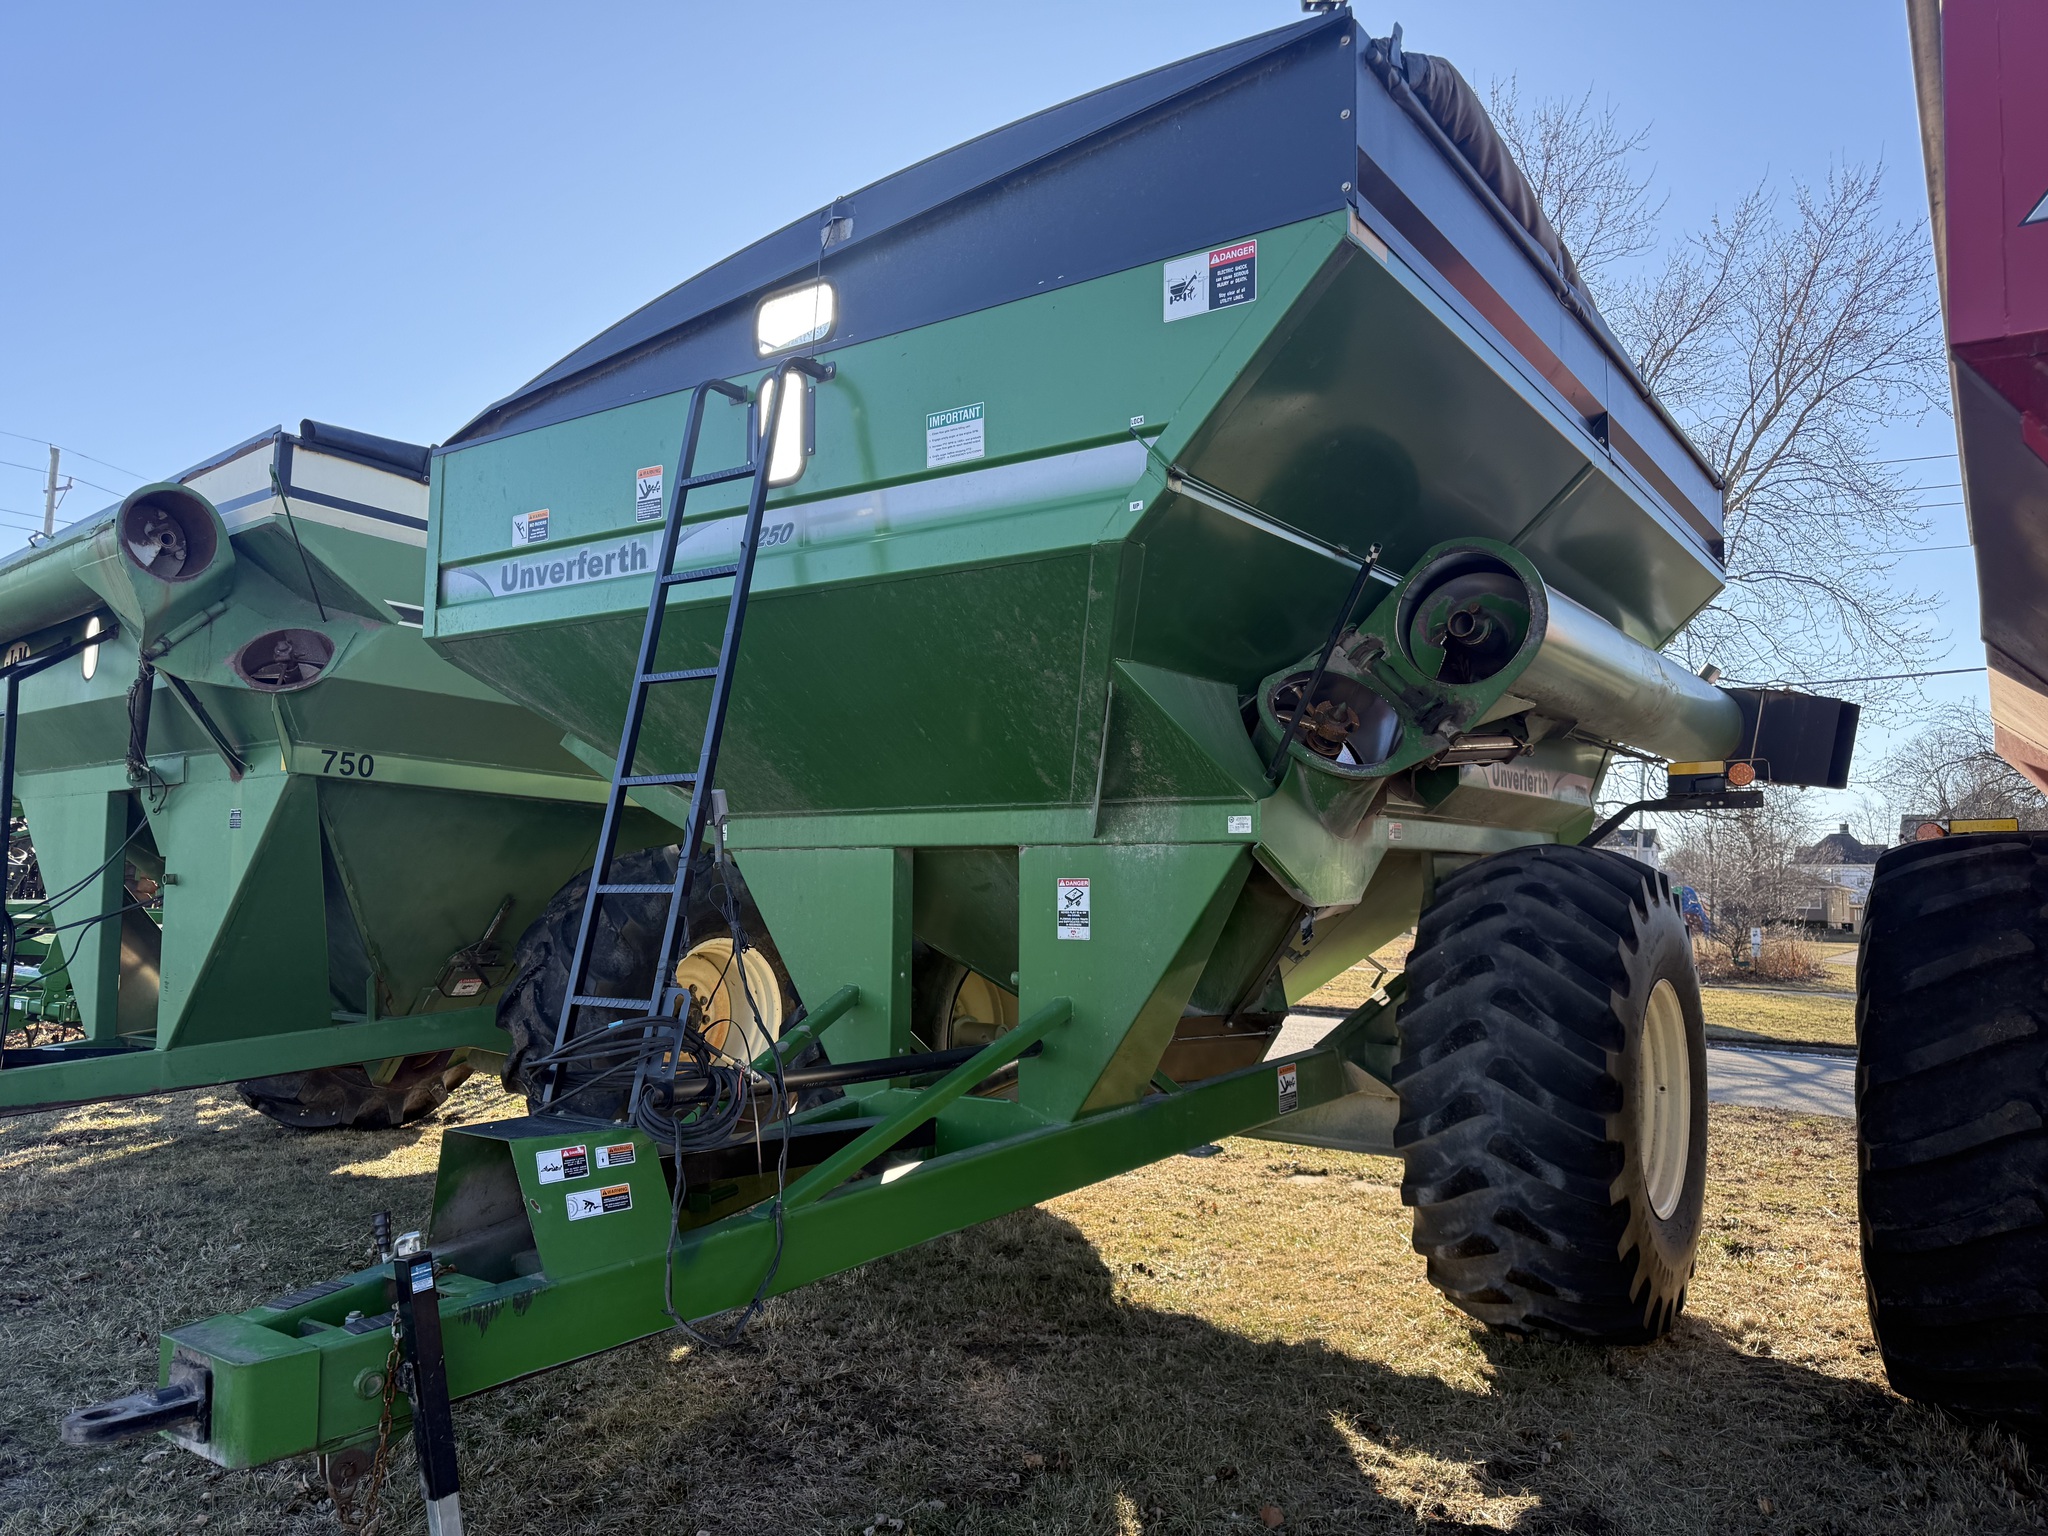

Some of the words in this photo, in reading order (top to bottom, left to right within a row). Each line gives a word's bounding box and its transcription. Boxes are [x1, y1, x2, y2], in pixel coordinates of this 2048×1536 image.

[1220, 245, 1255, 262] DANGER
[929, 406, 981, 428] IMPORTANT
[1132, 502, 1140, 510] UP
[501, 541, 647, 592] Unverferth
[321, 749, 374, 778] 750
[1492, 762, 1549, 796] Unverferth
[607, 1187, 628, 1195] WARNING
